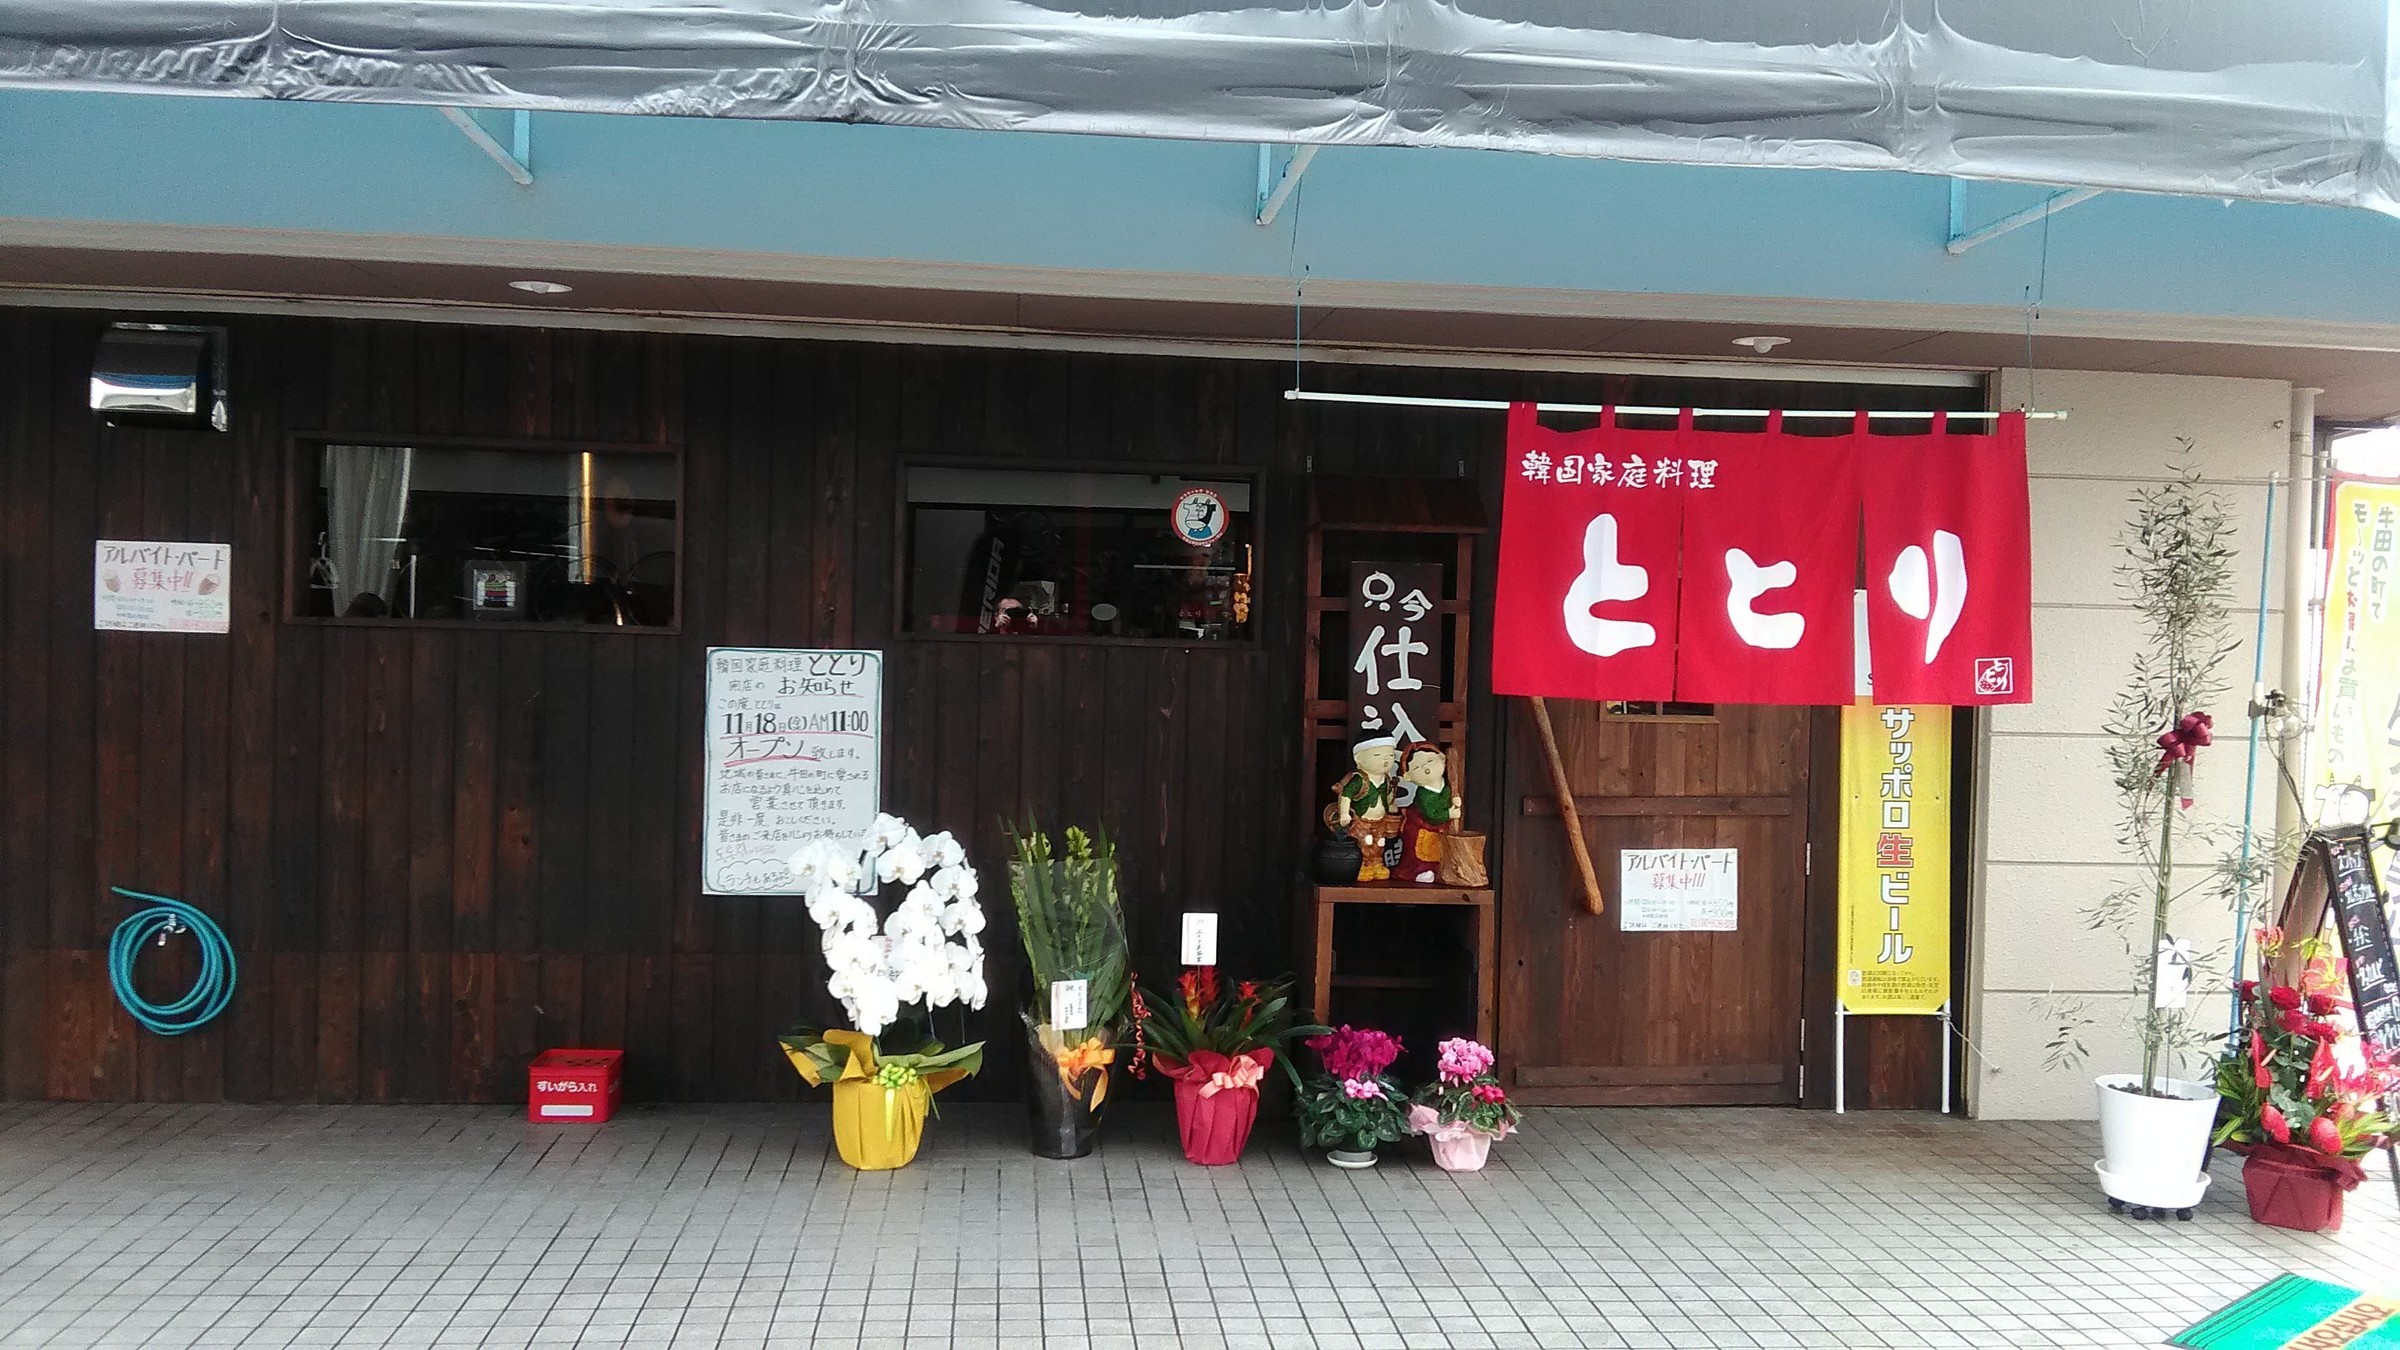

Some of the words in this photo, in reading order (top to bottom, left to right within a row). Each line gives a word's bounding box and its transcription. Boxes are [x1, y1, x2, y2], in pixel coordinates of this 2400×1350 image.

[1521, 449, 1719, 491] 韓国家庭料理
[103, 545, 226, 570] アルバイト・パート
[1562, 511, 1969, 665] ととり
[714, 656, 804, 673] 韓国家庭料理
[808, 654, 866, 677] ととり
[777, 676, 857, 696] お知らせ
[726, 736, 806, 760] オープン
[1875, 707, 1916, 965] サッポロ生ビール
[1626, 851, 1733, 874] アルバイト・パート
[536, 1080, 599, 1093] すいがら入れ
